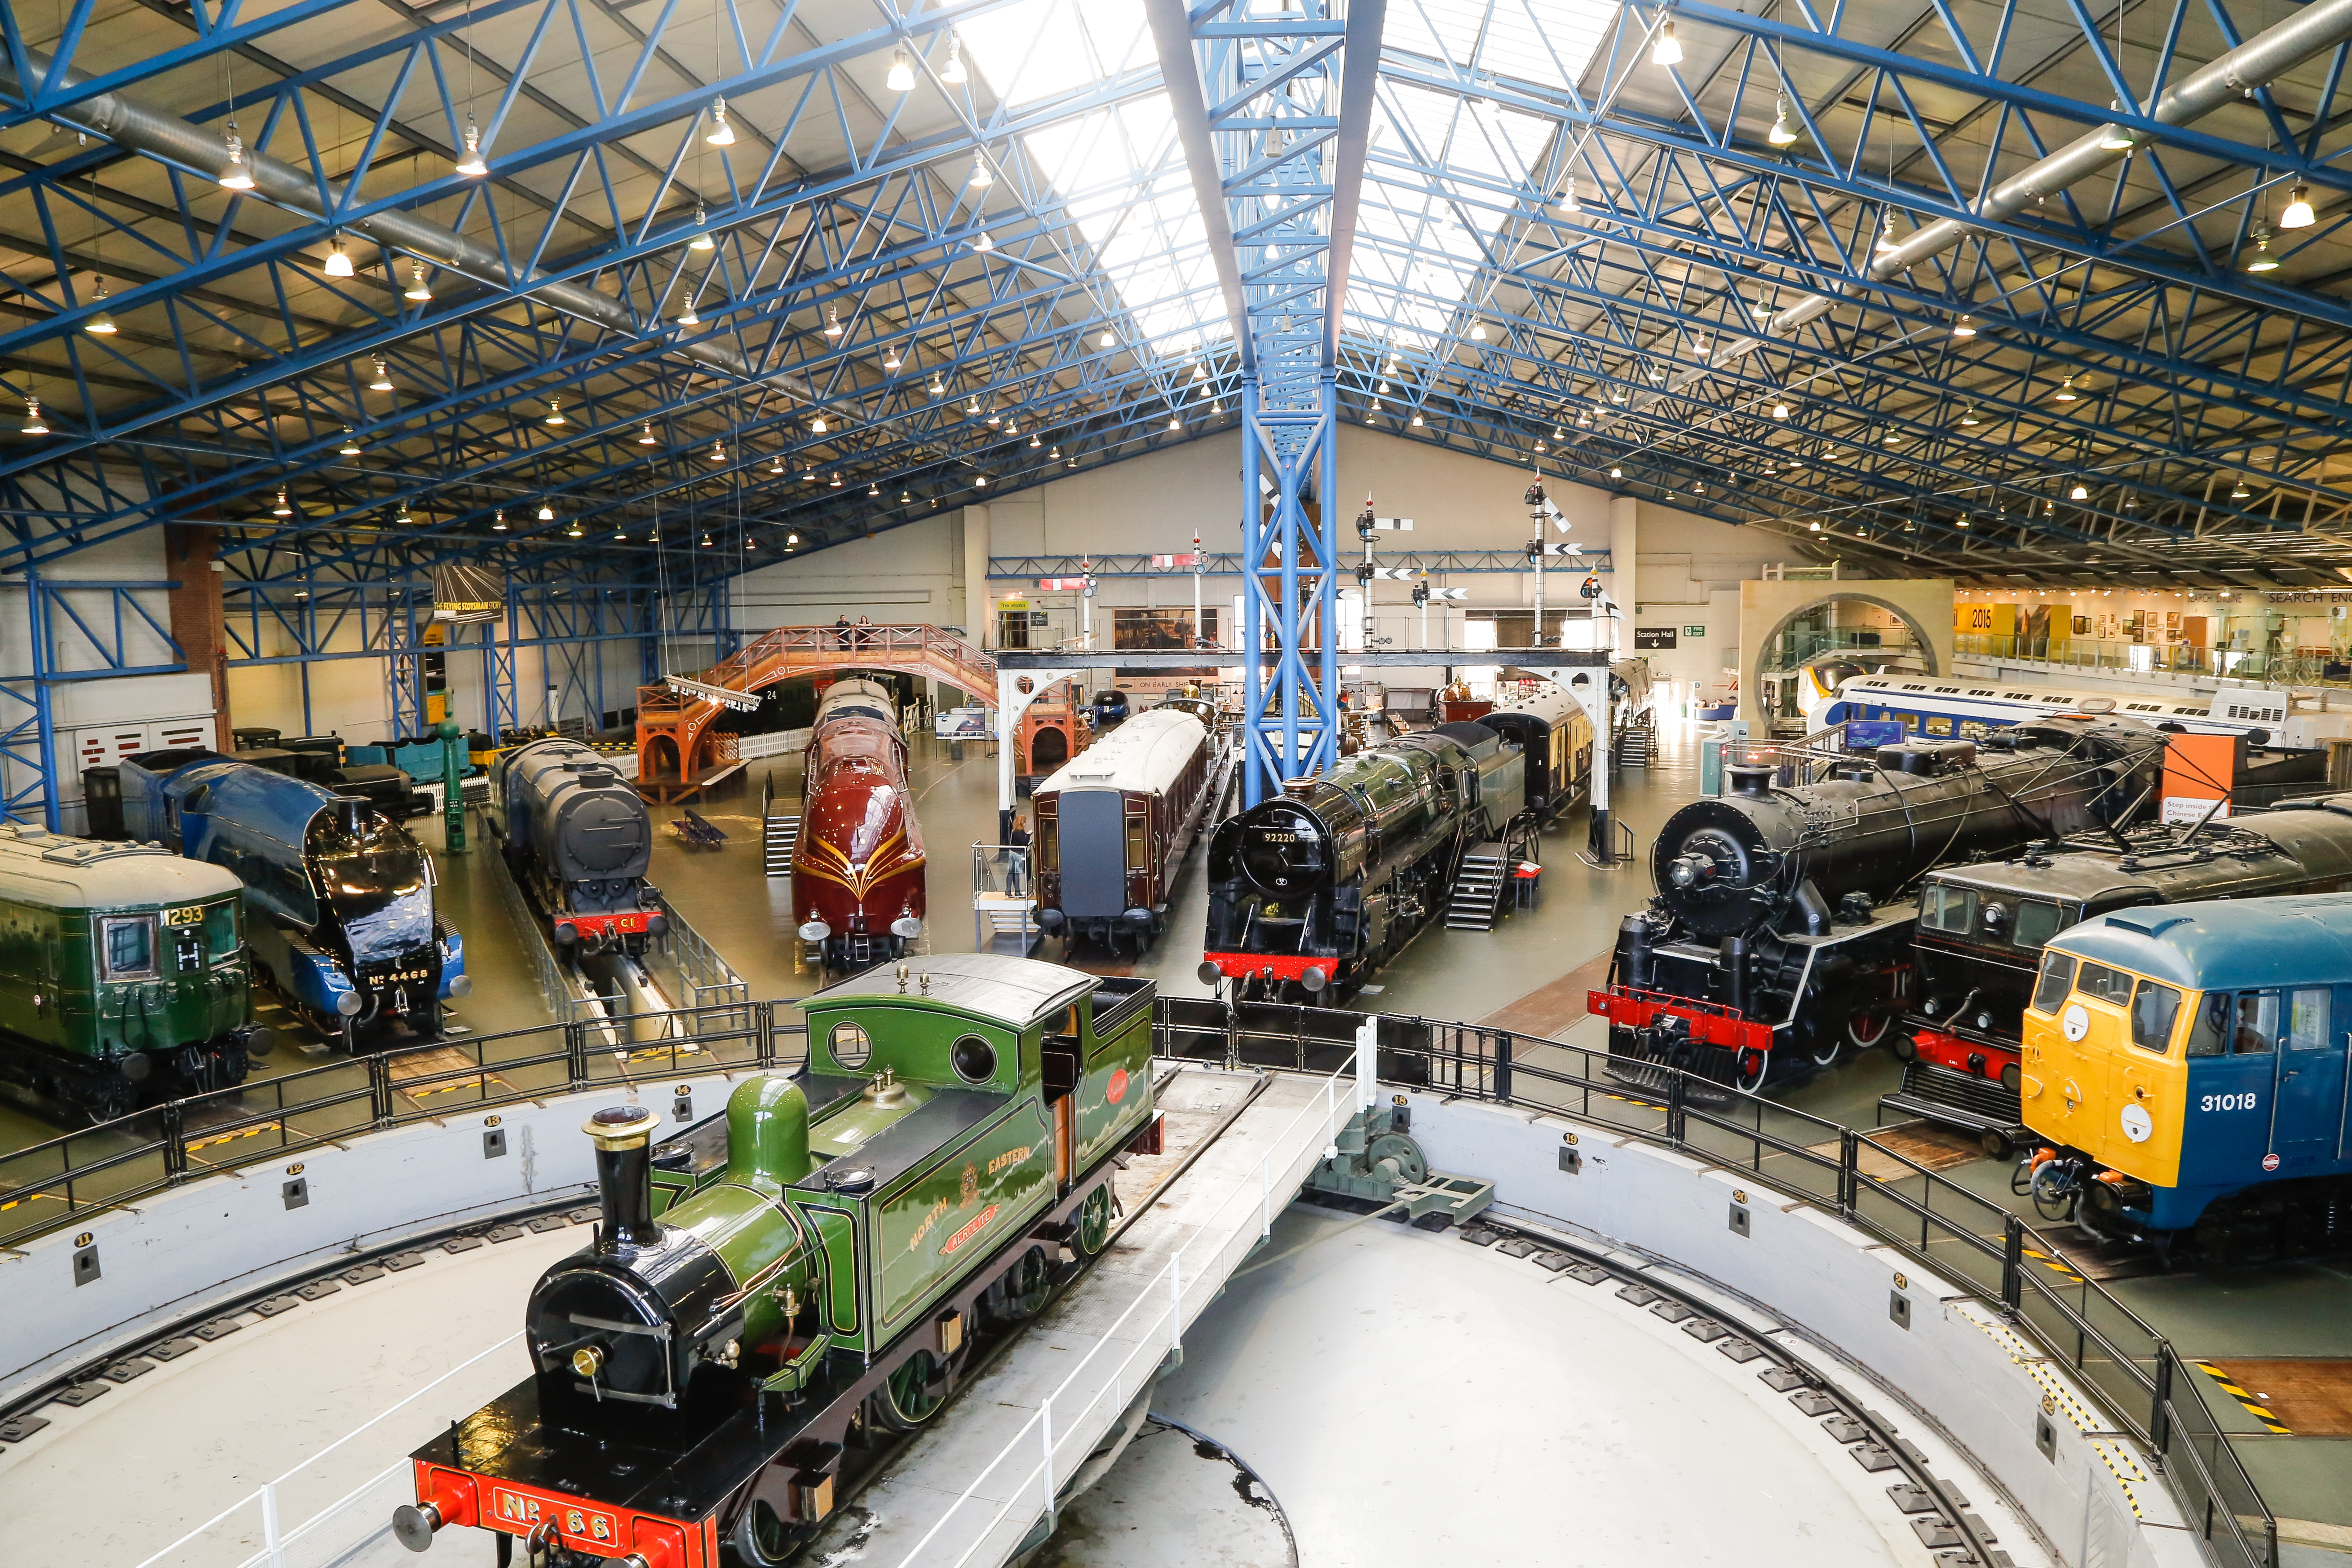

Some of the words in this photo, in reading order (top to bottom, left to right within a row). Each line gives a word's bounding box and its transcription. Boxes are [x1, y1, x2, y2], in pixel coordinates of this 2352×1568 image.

[2269, 593, 2323, 603] SEARCH
[462, 602, 488, 610] SCOTSMAN
[1972, 609, 1991, 628] 2015
[767, 690, 776, 699] 24
[1265, 833, 1295, 842] 92220
[164, 906, 203, 926] 1293
[389, 969, 428, 982] 4468
[677, 1086, 689, 1095] 14
[1395, 1095, 1406, 1105] 18
[2201, 1092, 2256, 1112] 31018
[486, 1115, 500, 1126] 13
[1565, 1133, 1577, 1144] 19
[288, 1163, 304, 1175] 12
[910, 1197, 948, 1252] NORTH
[988, 1146, 1030, 1175] EASTERN
[1734, 1190, 1748, 1204] 20
[952, 1209, 991, 1249] AEROLITE
[77, 1232, 91, 1247] 11
[1895, 1272, 1907, 1289] 21
[2043, 1395, 2055, 1415] 22
[566, 1509, 610, 1541] 66
